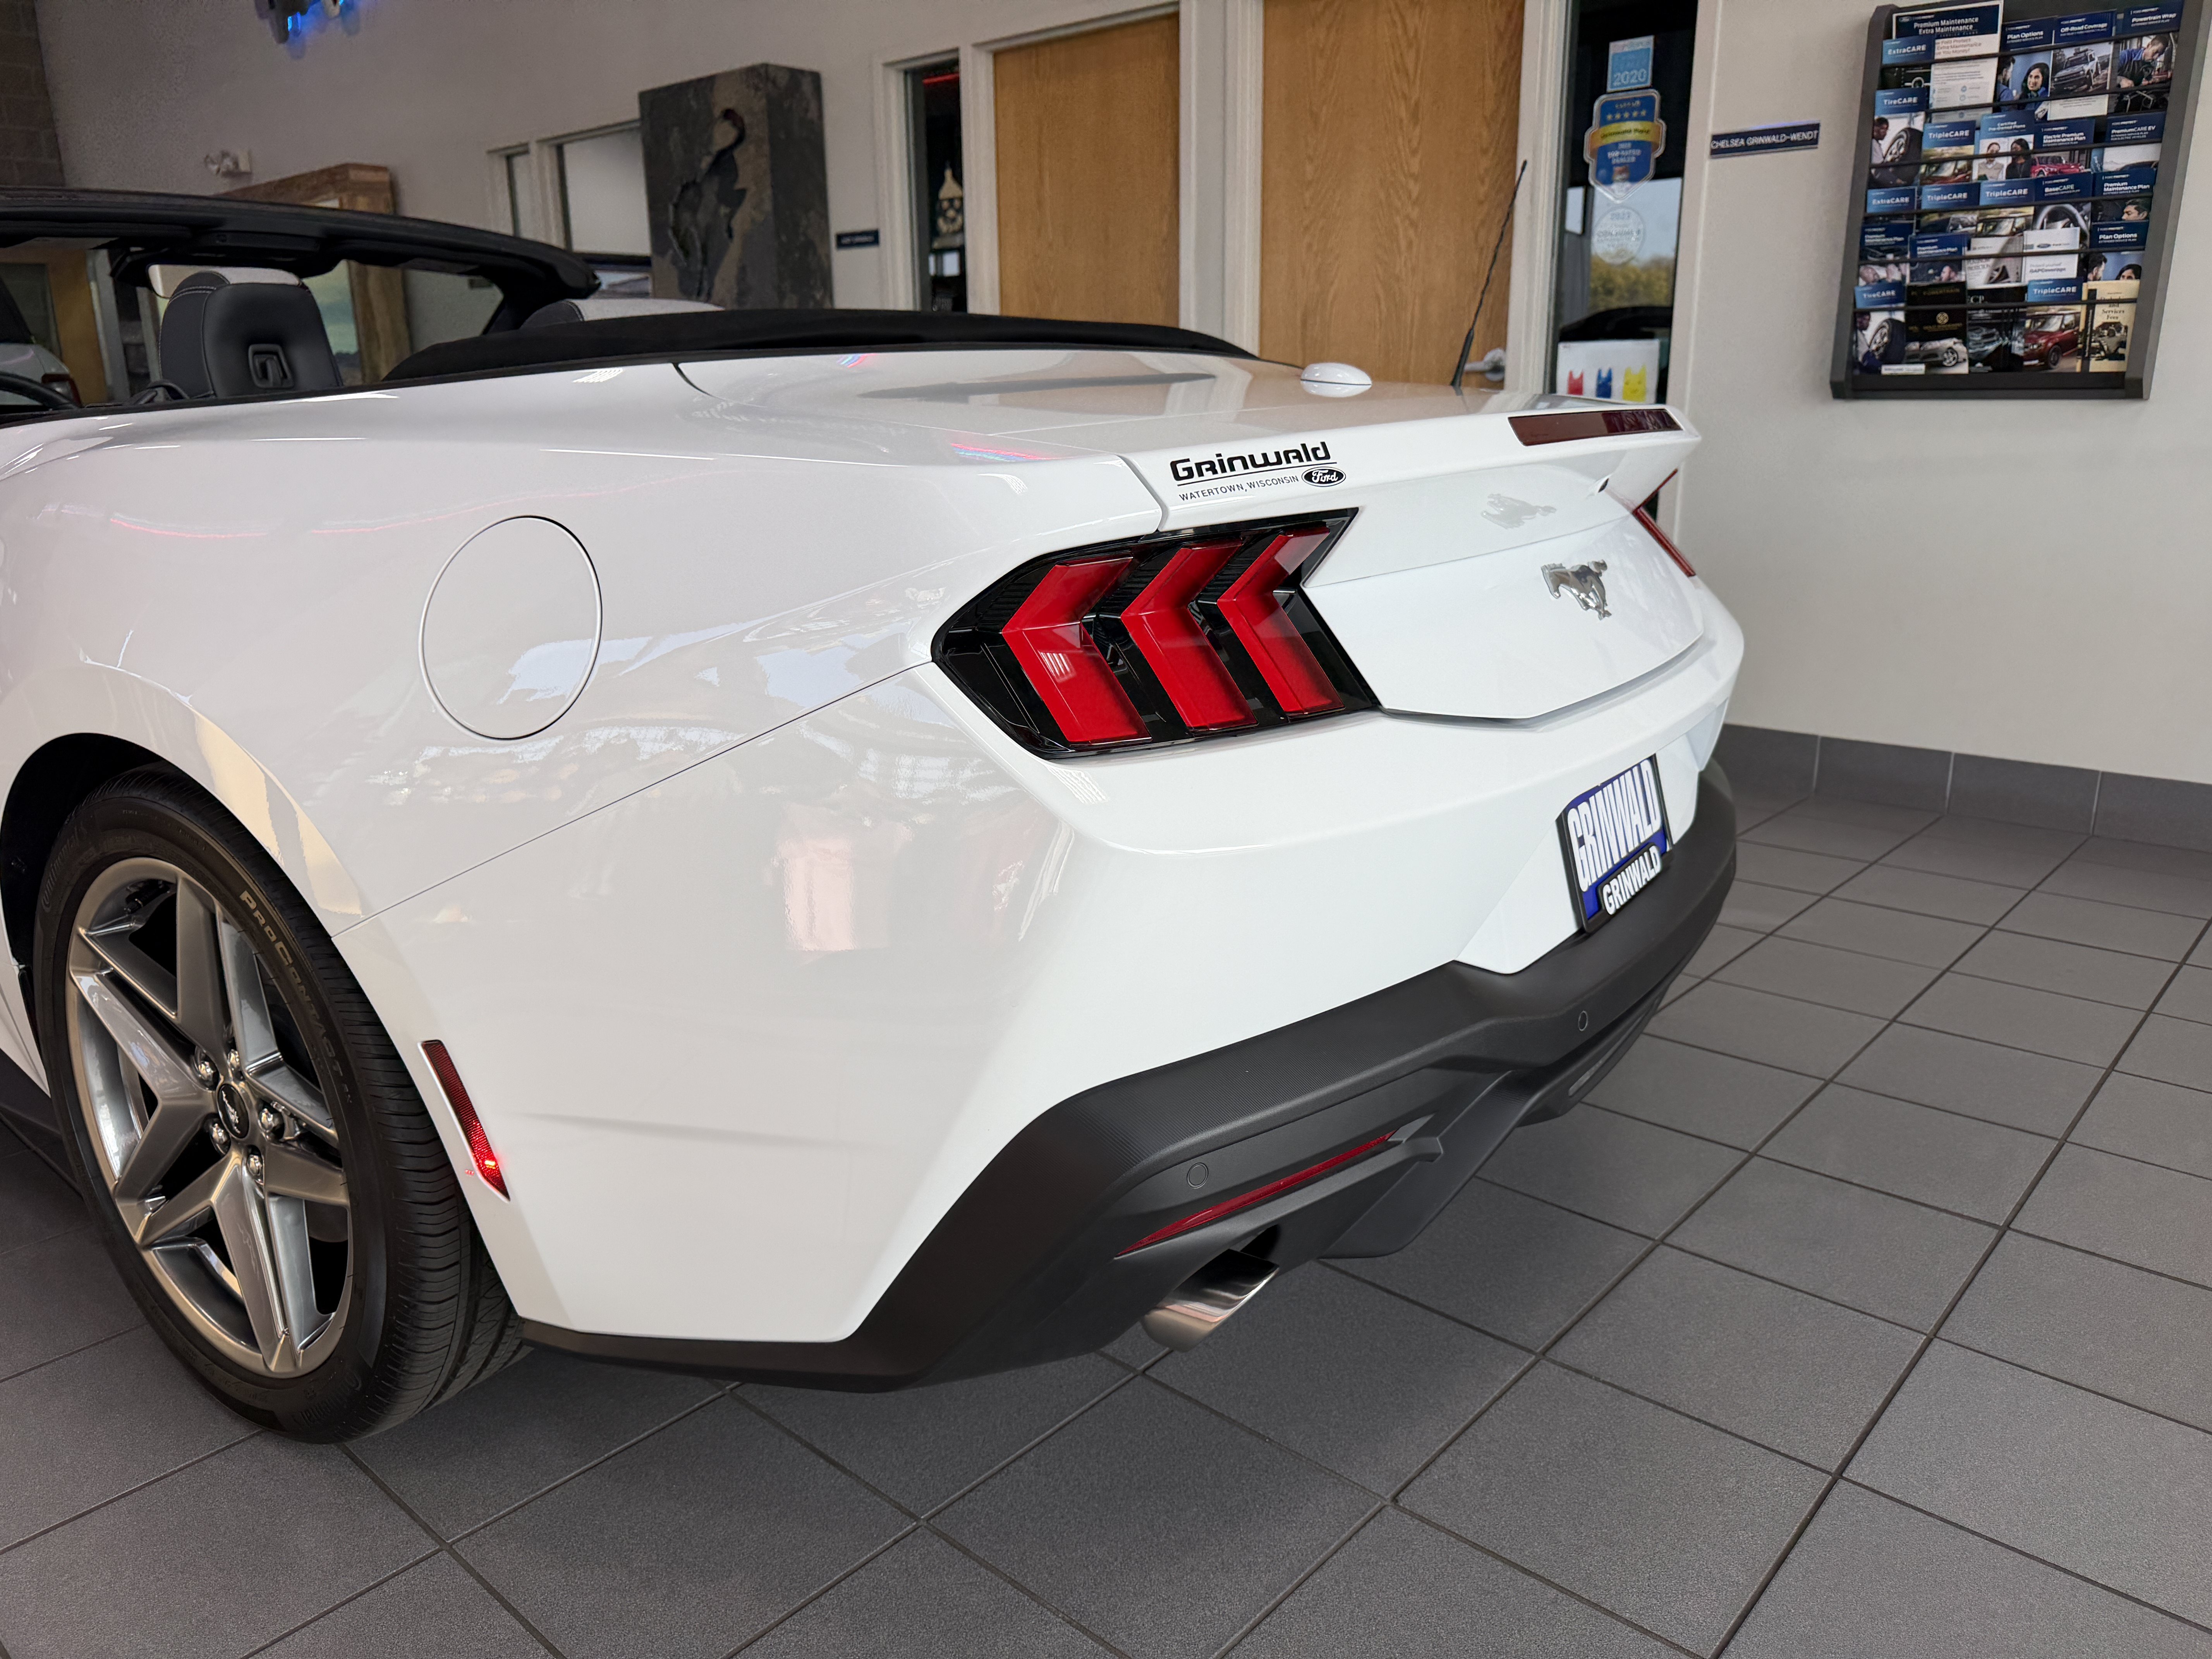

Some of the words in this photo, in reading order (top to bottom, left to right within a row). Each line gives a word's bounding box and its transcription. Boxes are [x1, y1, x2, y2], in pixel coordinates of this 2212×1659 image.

[1914, 21, 1939, 29] Premium
[1941, 17, 1978, 26] Maintenance
[1936, 24, 1973, 33] Maintenance
[1888, 45, 1926, 55] ExtraCARE
[1613, 69, 1647, 86] 2020
[1884, 96, 1918, 105] TireCARE
[1711, 138, 1745, 149] CHELSEA
[1746, 130, 1819, 146] GRINWALD-WENDT
[1928, 130, 1970, 139] TripleCARE
[1986, 188, 2028, 198] TripleCARE
[2045, 184, 2075, 193] BaseCARE
[1872, 197, 1910, 205] ExtraCARE
[1927, 192, 1968, 202] TripleCARE
[1863, 290, 1896, 299] TireCARE
[2033, 286, 2077, 295] TripleCARE
[1170, 441, 1331, 481] Grinwald
[1312, 471, 1339, 483] Ford
[1247, 476, 1299, 489] WISCONSIN
[1568, 759, 1662, 892] GRINWALD
[1602, 845, 1662, 915] GRINWALD
